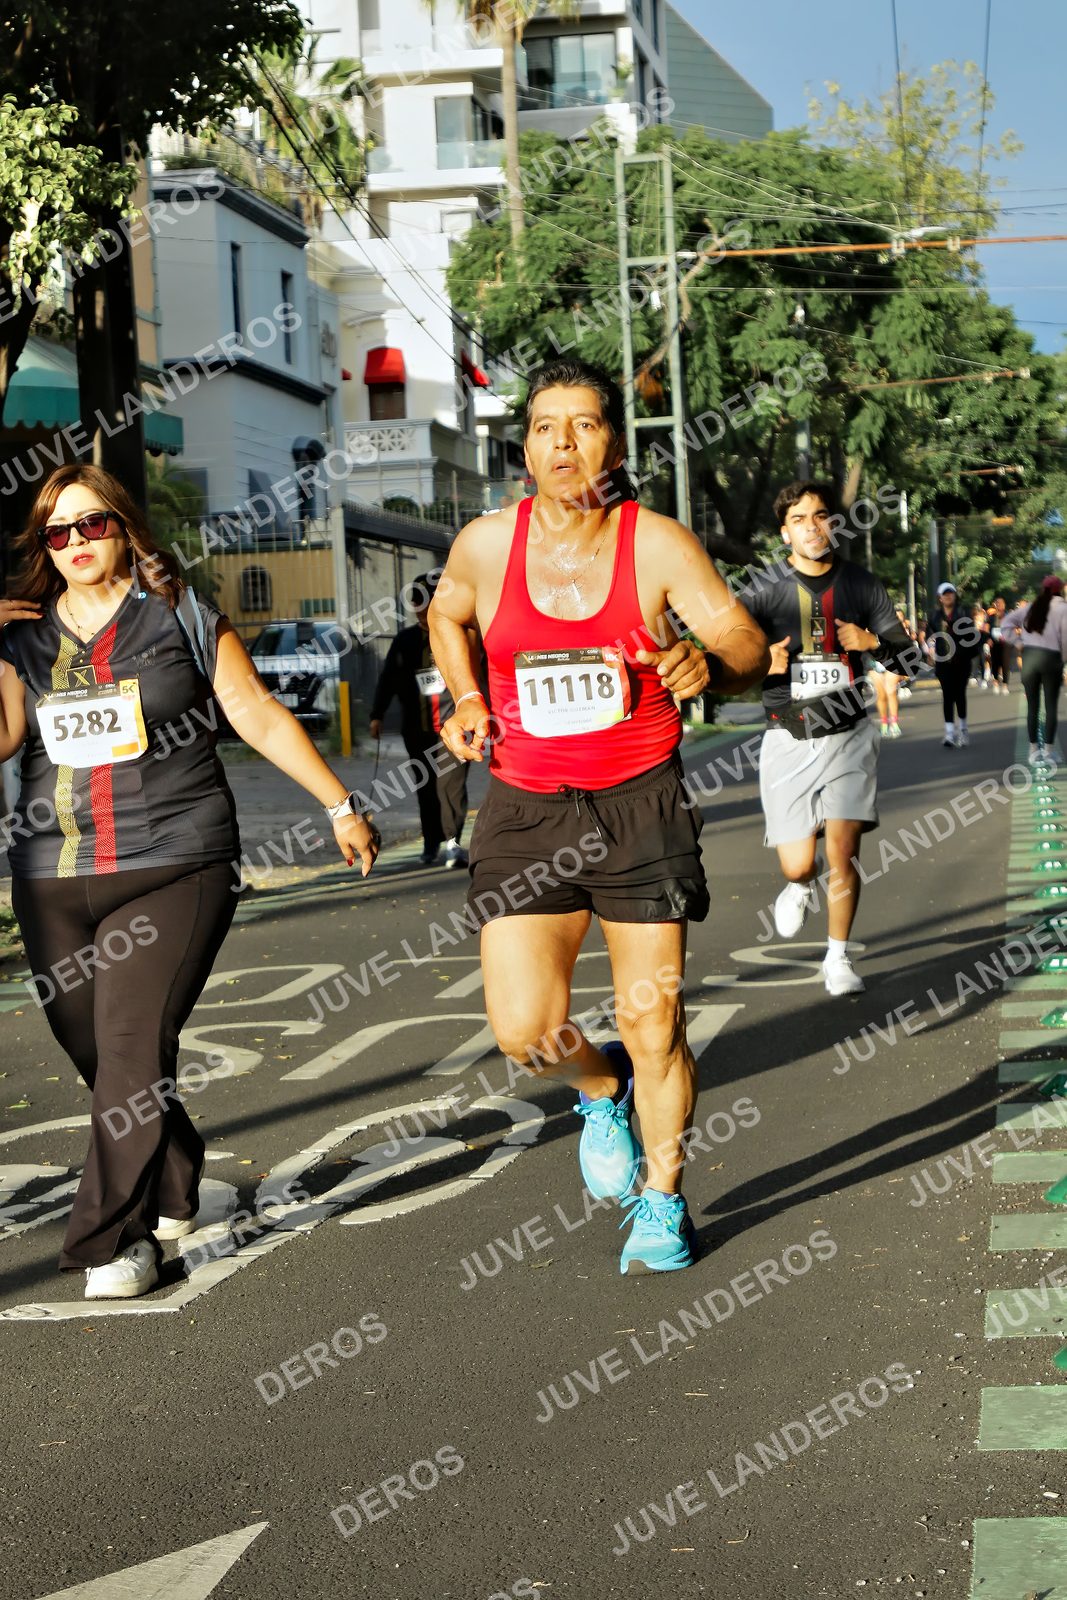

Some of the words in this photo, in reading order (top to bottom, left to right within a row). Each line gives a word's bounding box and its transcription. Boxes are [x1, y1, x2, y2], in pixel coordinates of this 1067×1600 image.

[523, 672, 615, 706] 11118
[800, 668, 840, 685] 9139
[122, 685, 135, 694] 5K
[54, 708, 122, 742] 5282
